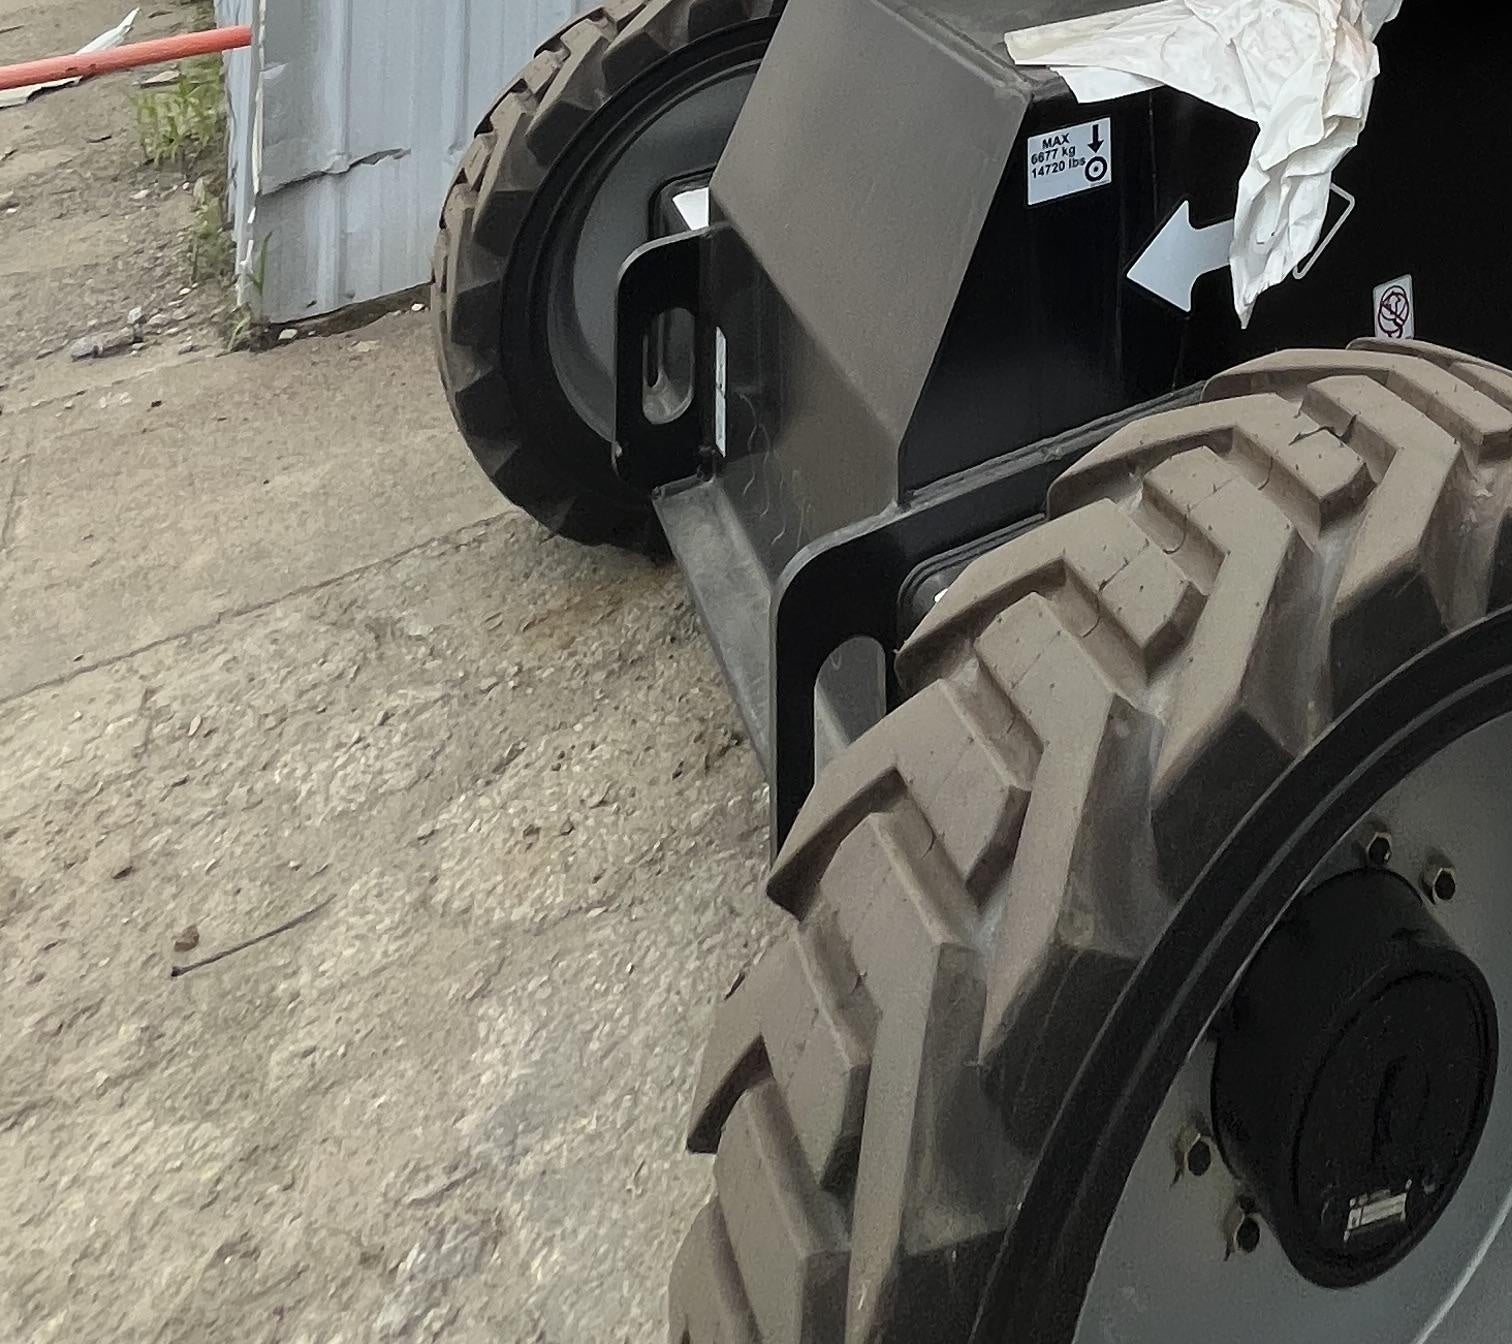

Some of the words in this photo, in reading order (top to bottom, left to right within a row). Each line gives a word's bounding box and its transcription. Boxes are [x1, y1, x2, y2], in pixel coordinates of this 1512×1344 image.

[1042, 133, 1070, 150] MAX
[1031, 148, 1059, 165] 6677
[1062, 146, 1076, 158] kg
[1031, 160, 1066, 179] 14720
[1068, 157, 1086, 169] lbs
